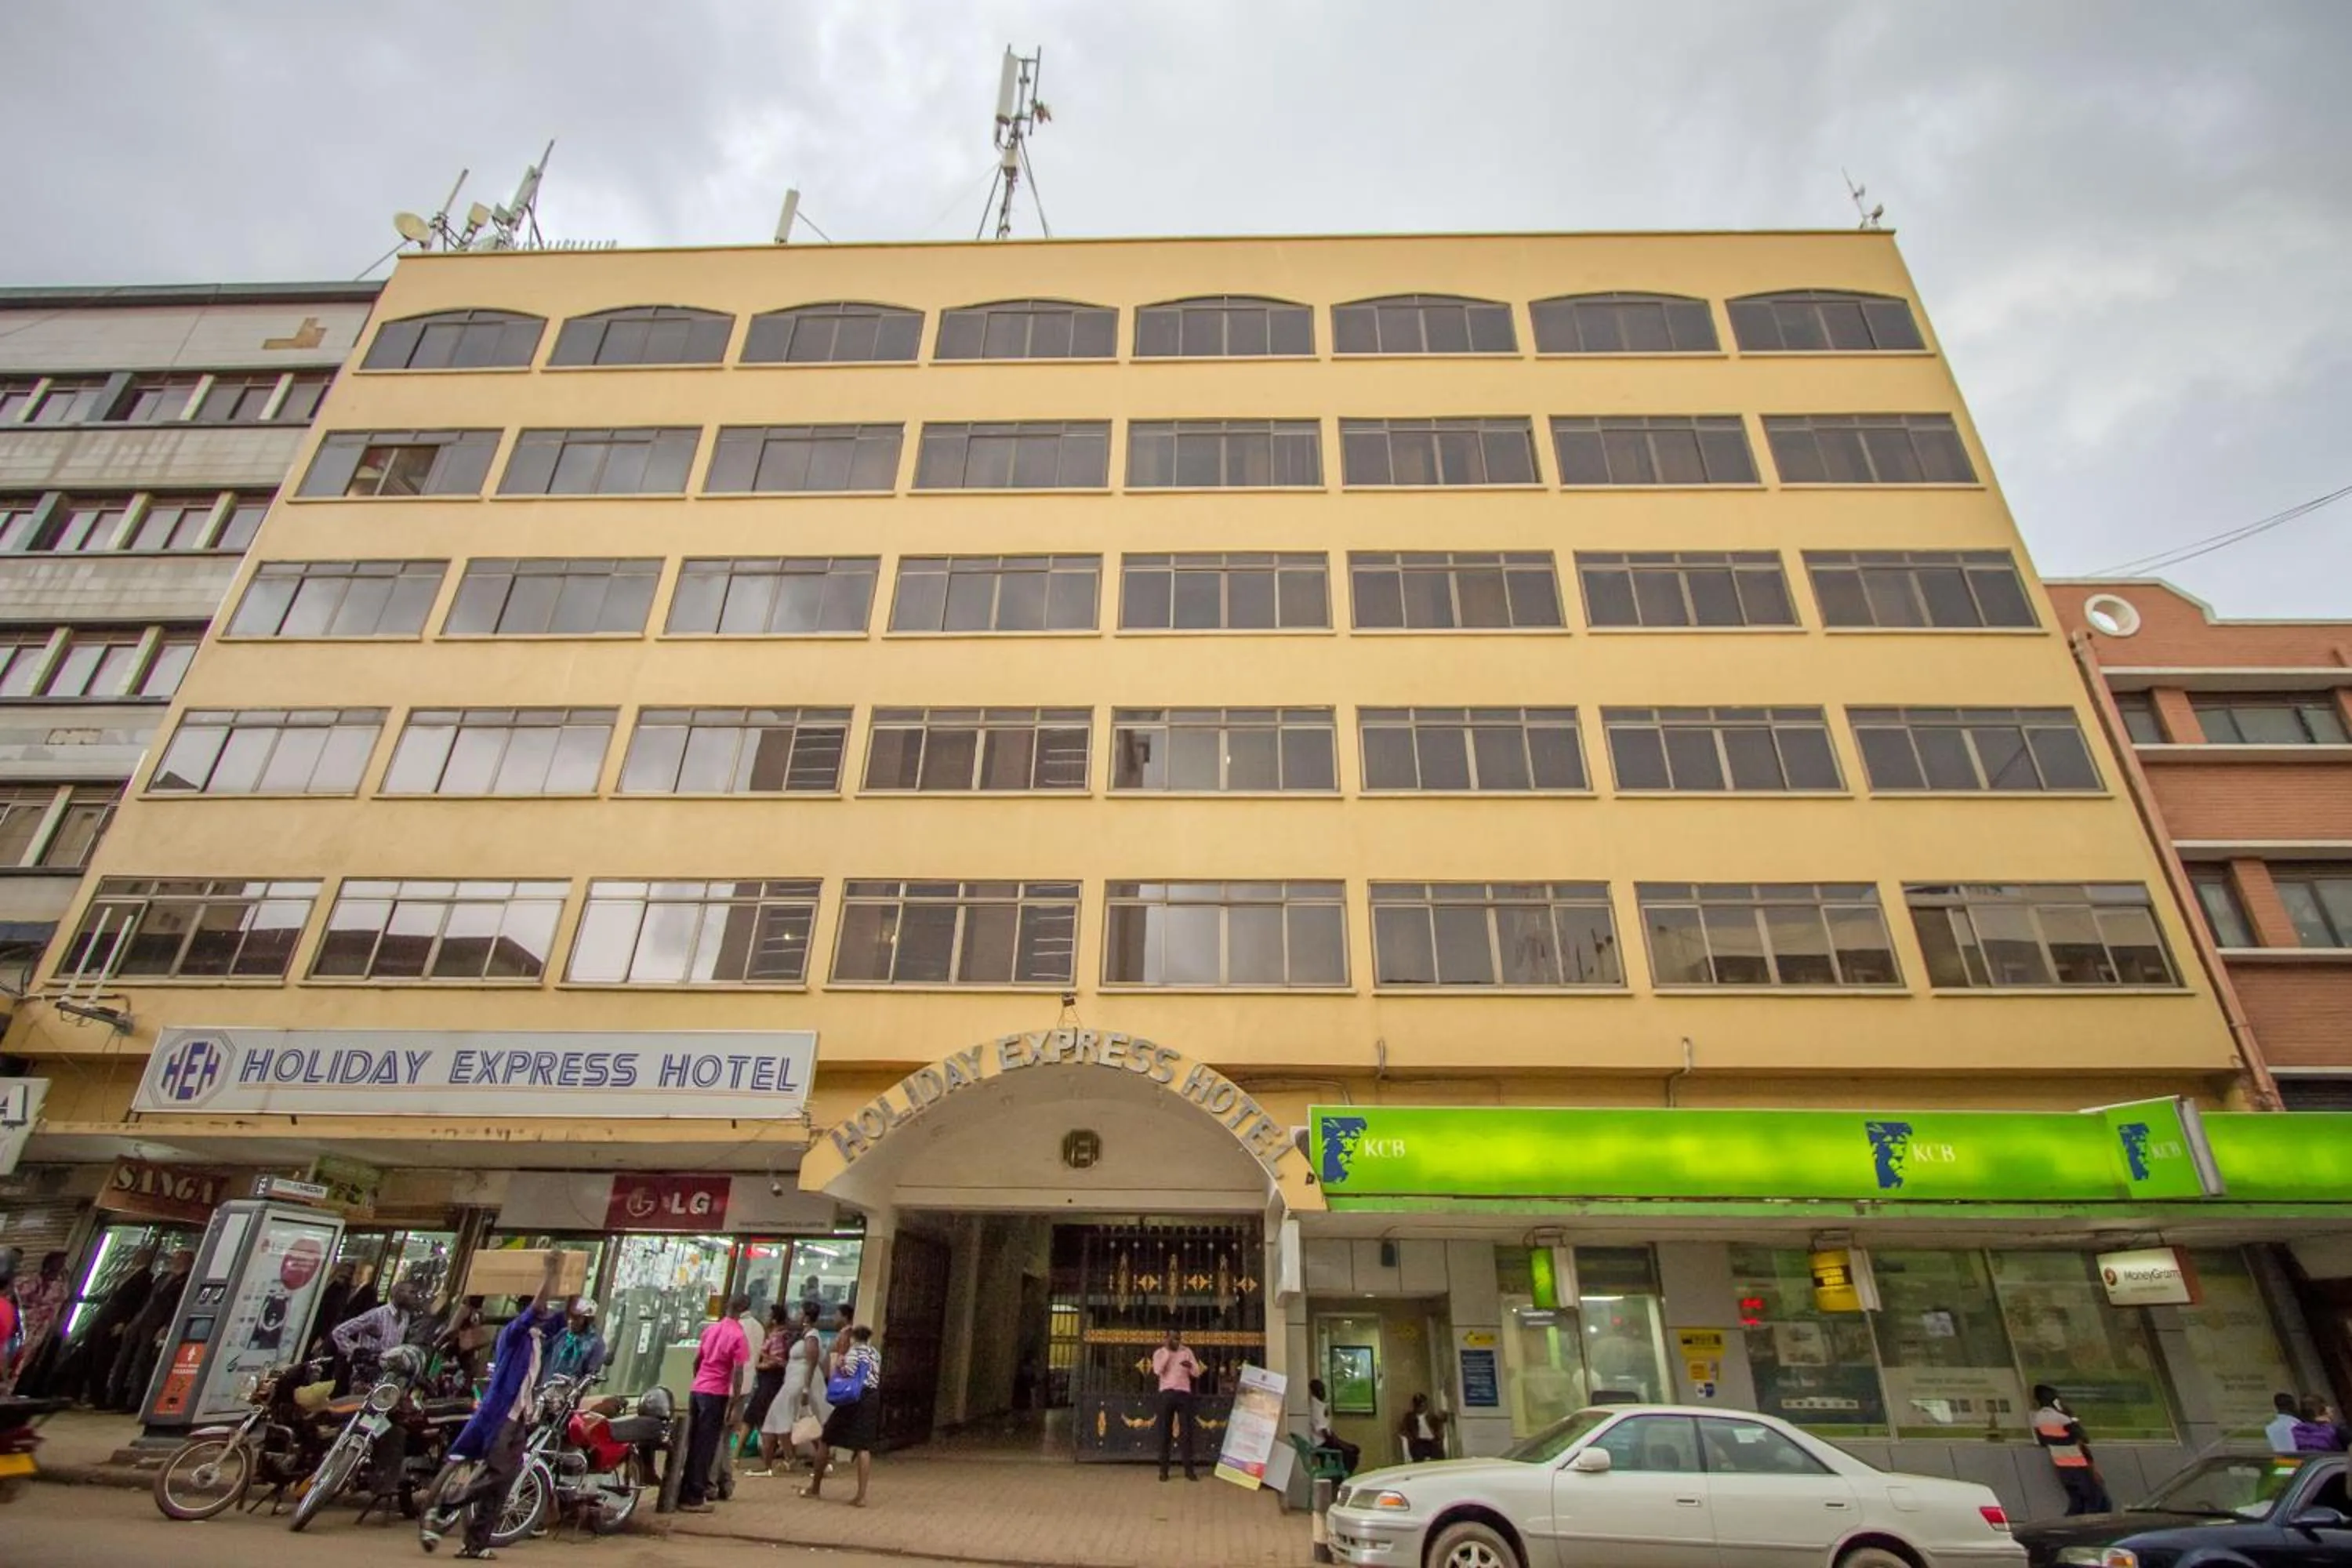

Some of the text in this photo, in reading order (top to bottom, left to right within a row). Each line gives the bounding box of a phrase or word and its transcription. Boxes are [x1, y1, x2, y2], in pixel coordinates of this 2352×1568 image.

[238, 1048, 798, 1092] HOLIDAY EXPRESS HOTEL
[831, 1027, 1295, 1179] HOLIDAY EXPRESS HOTEL
[1364, 1138, 1406, 1158] KCB
[1912, 1142, 1956, 1162] KCB
[2151, 1140, 2183, 1160] KCB
[670, 1192, 712, 1214] LG
[2123, 1268, 2180, 1283] MoneyGram
